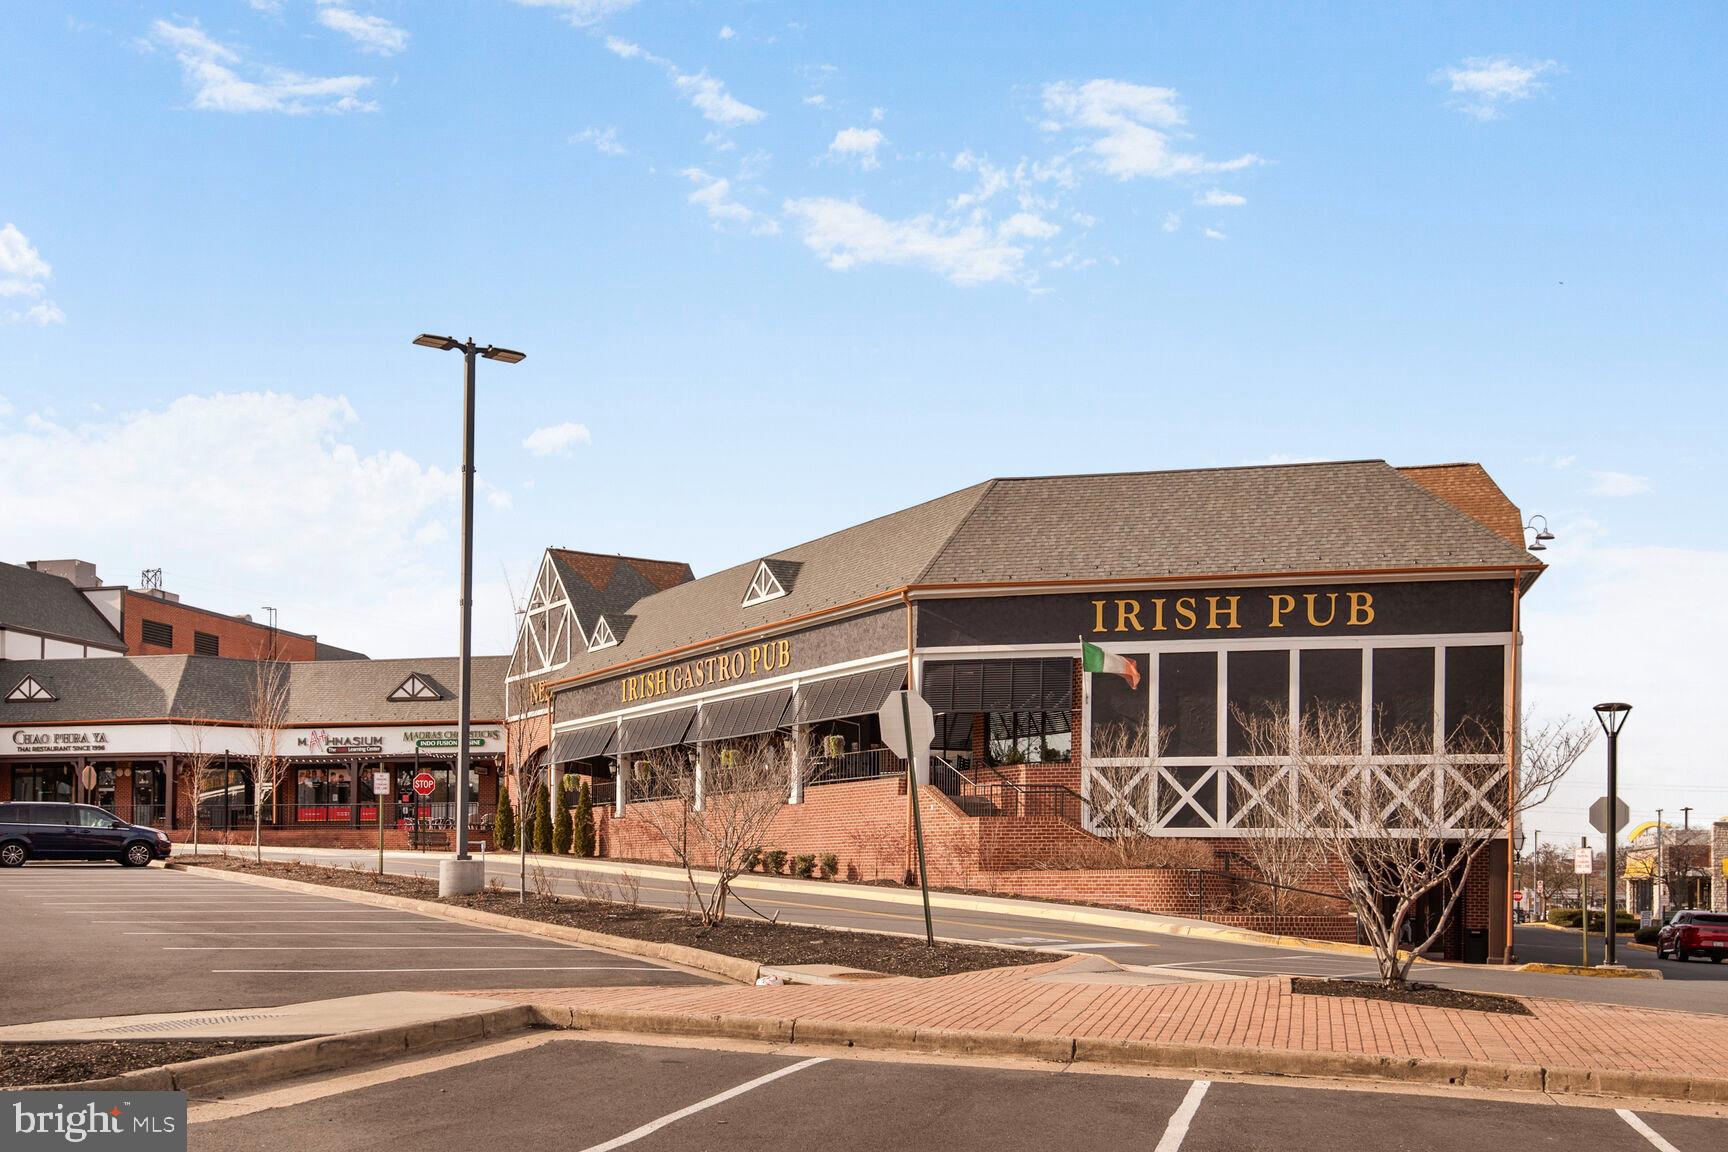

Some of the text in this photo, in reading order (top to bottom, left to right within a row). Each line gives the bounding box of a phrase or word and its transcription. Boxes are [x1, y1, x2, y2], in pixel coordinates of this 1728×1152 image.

[1091, 591, 1376, 633] IRISH PUB
[621, 639, 791, 703] IRISH GASTRO PUB
[92, 732, 109, 743] YA
[403, 730, 500, 742] MADRAS CHSTICKS
[415, 780, 434, 789] STOP
